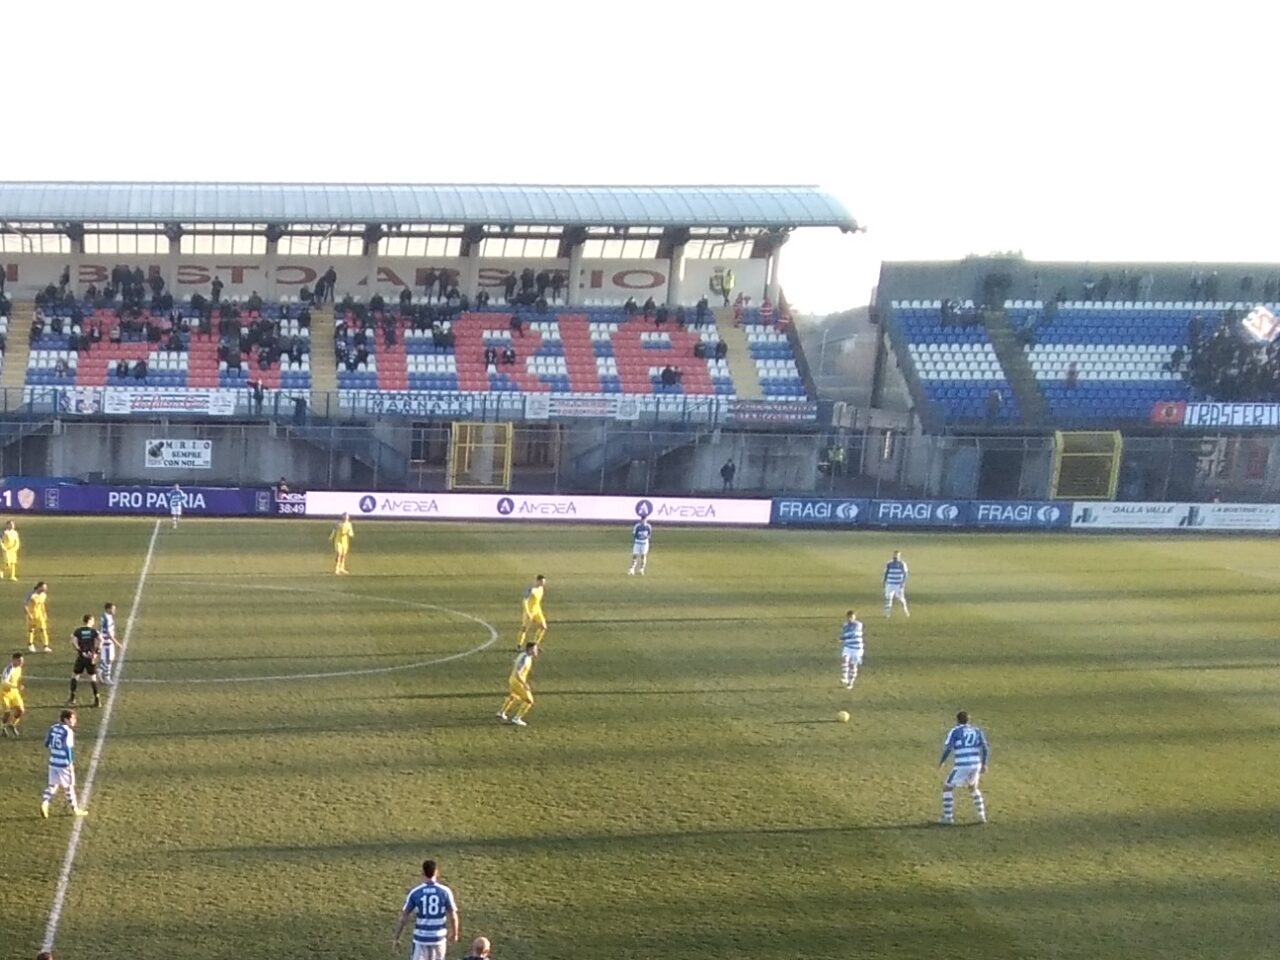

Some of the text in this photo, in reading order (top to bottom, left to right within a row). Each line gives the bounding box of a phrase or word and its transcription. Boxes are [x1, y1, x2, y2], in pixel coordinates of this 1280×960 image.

[372, 400, 465, 410] MARNATE
[1187, 402, 1280, 426] TRASFERT
[108, 491, 143, 508] PRO
[779, 501, 832, 518] FRAGI
[878, 503, 932, 520] FRAGI
[977, 504, 1033, 521] FRAGI
[420, 894, 440, 916] 18
